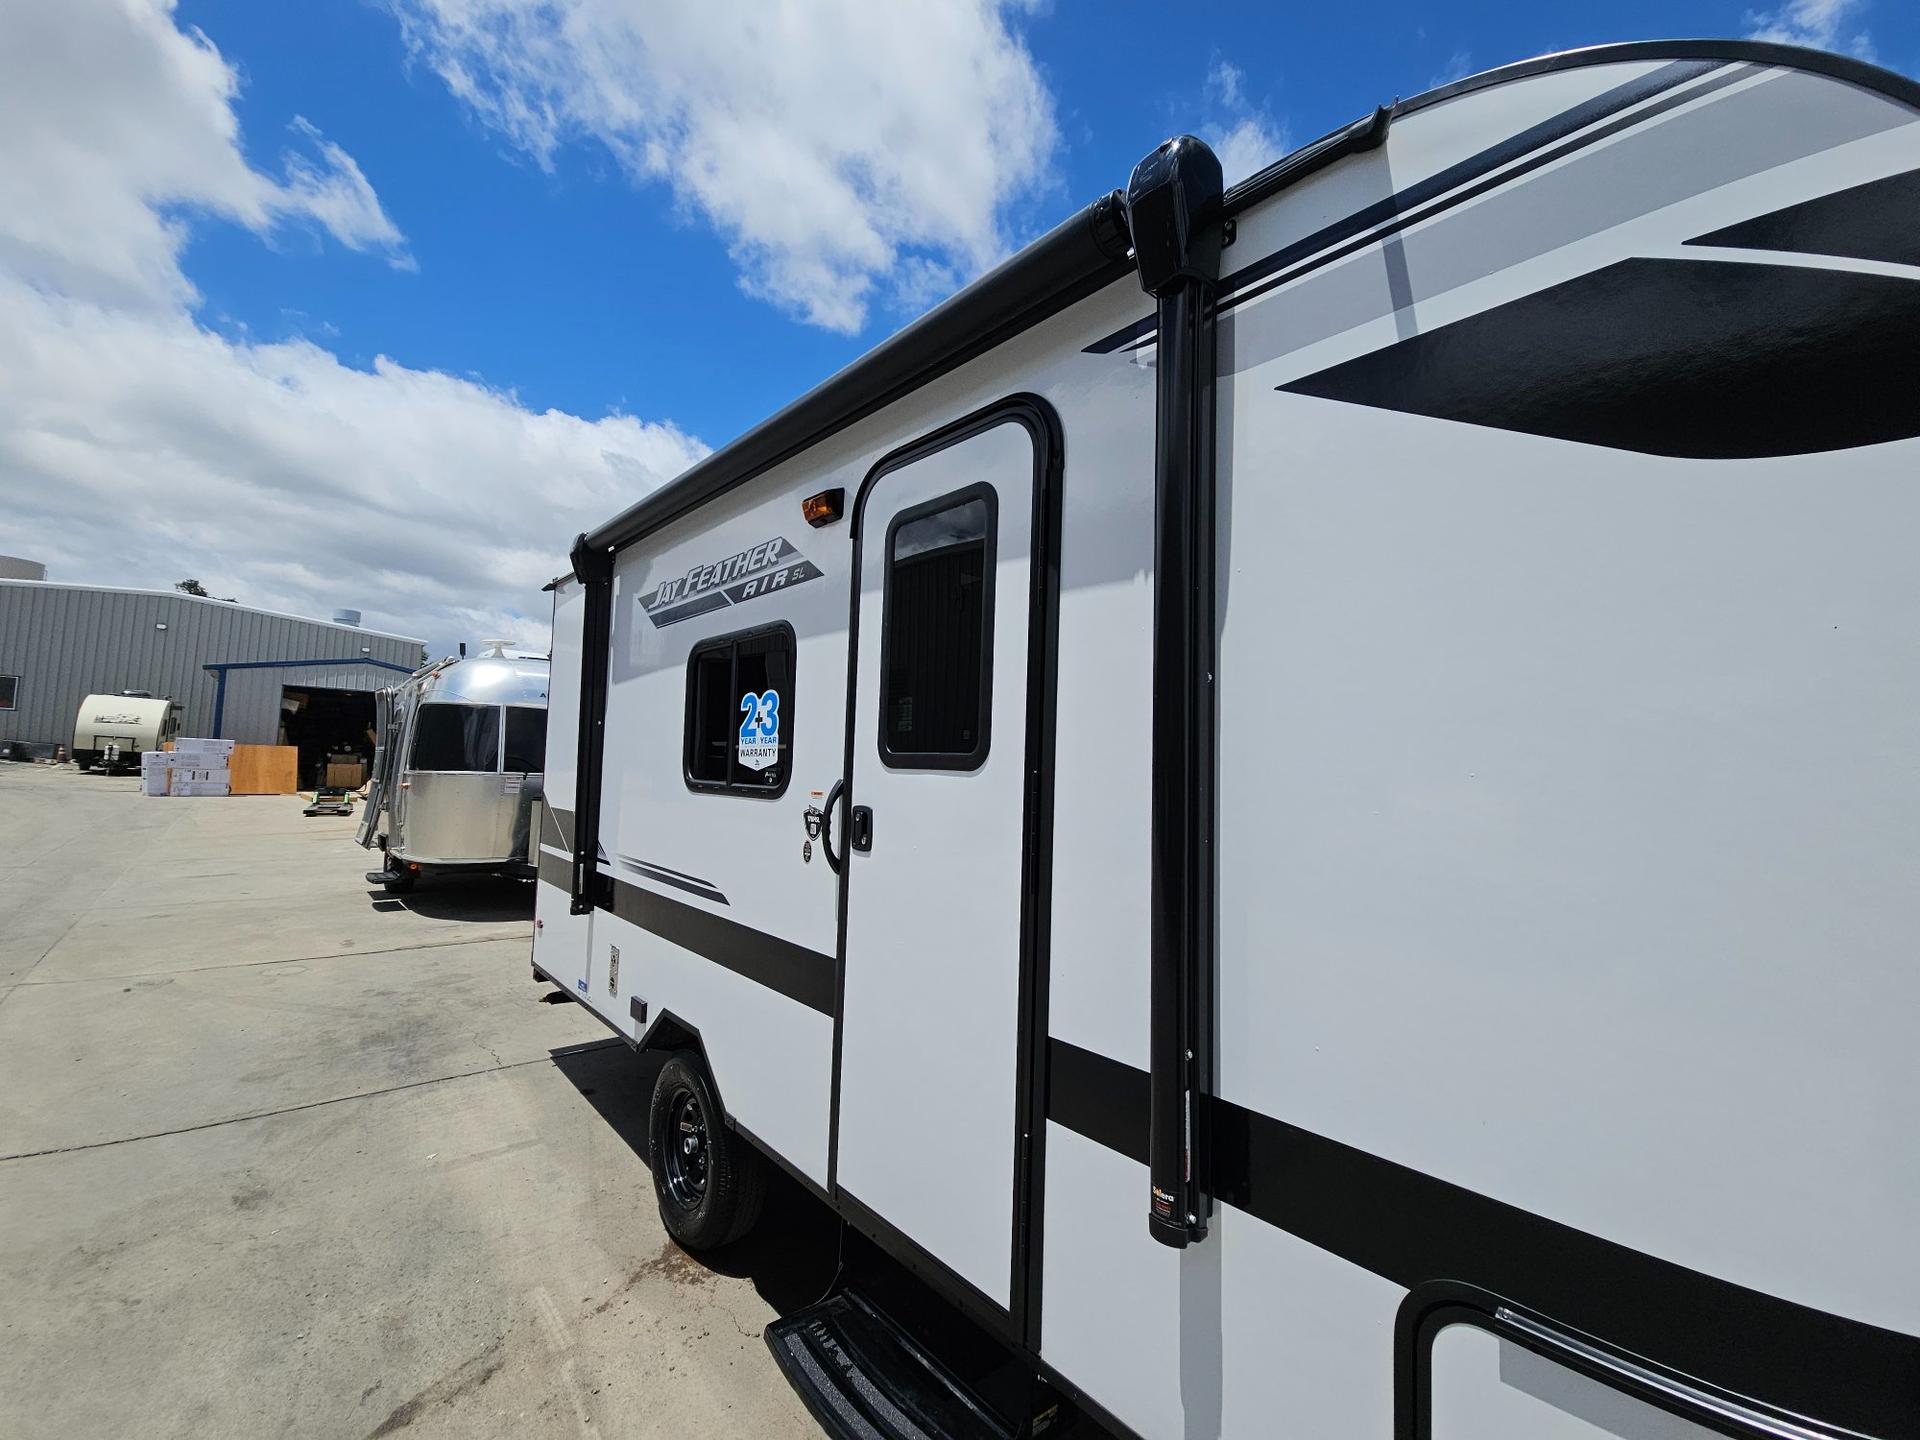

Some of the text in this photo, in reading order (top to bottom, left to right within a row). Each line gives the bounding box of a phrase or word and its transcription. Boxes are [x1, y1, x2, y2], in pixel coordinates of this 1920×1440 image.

[648, 537, 784, 610] JAY FEATHER
[742, 567, 806, 599] AIR SL
[740, 738, 756, 746] YEAR
[760, 736, 777, 745] YEAR
[740, 748, 777, 758] WARRANTY
